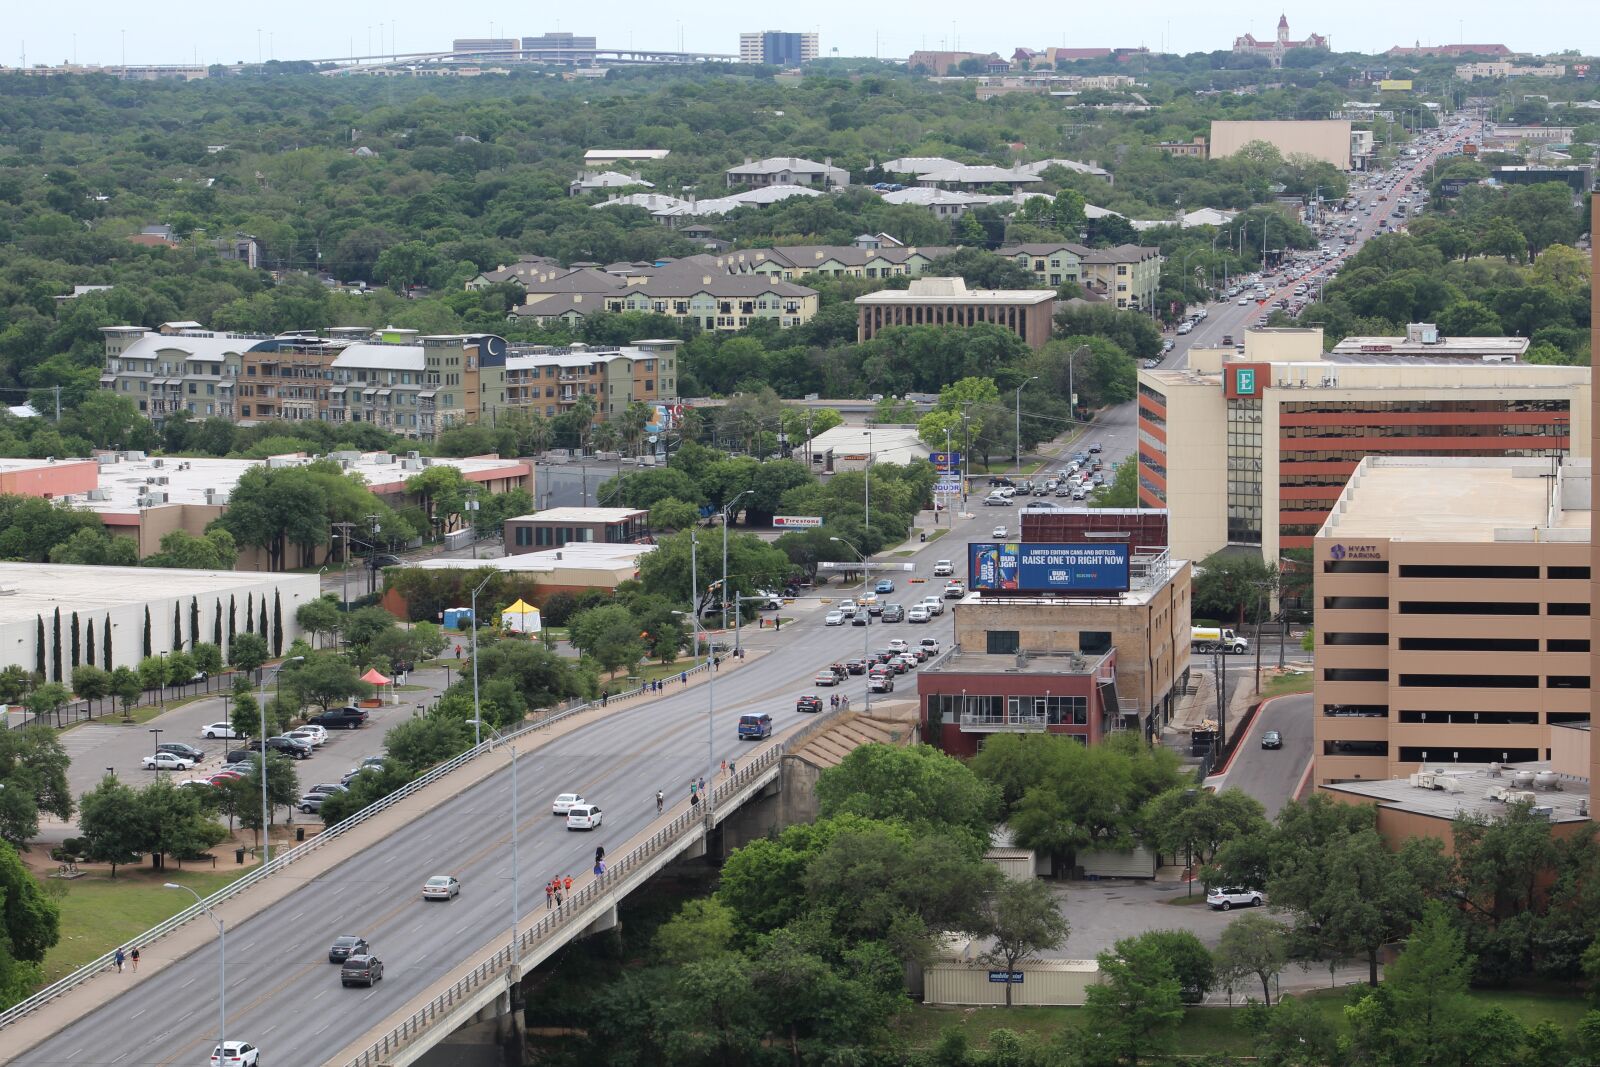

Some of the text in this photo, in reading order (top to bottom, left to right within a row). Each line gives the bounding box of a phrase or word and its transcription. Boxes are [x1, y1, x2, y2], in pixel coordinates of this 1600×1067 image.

[1240, 374, 1252, 390] E
[1022, 556, 1124, 564] RAISE ONE TO RIGHT NOW
